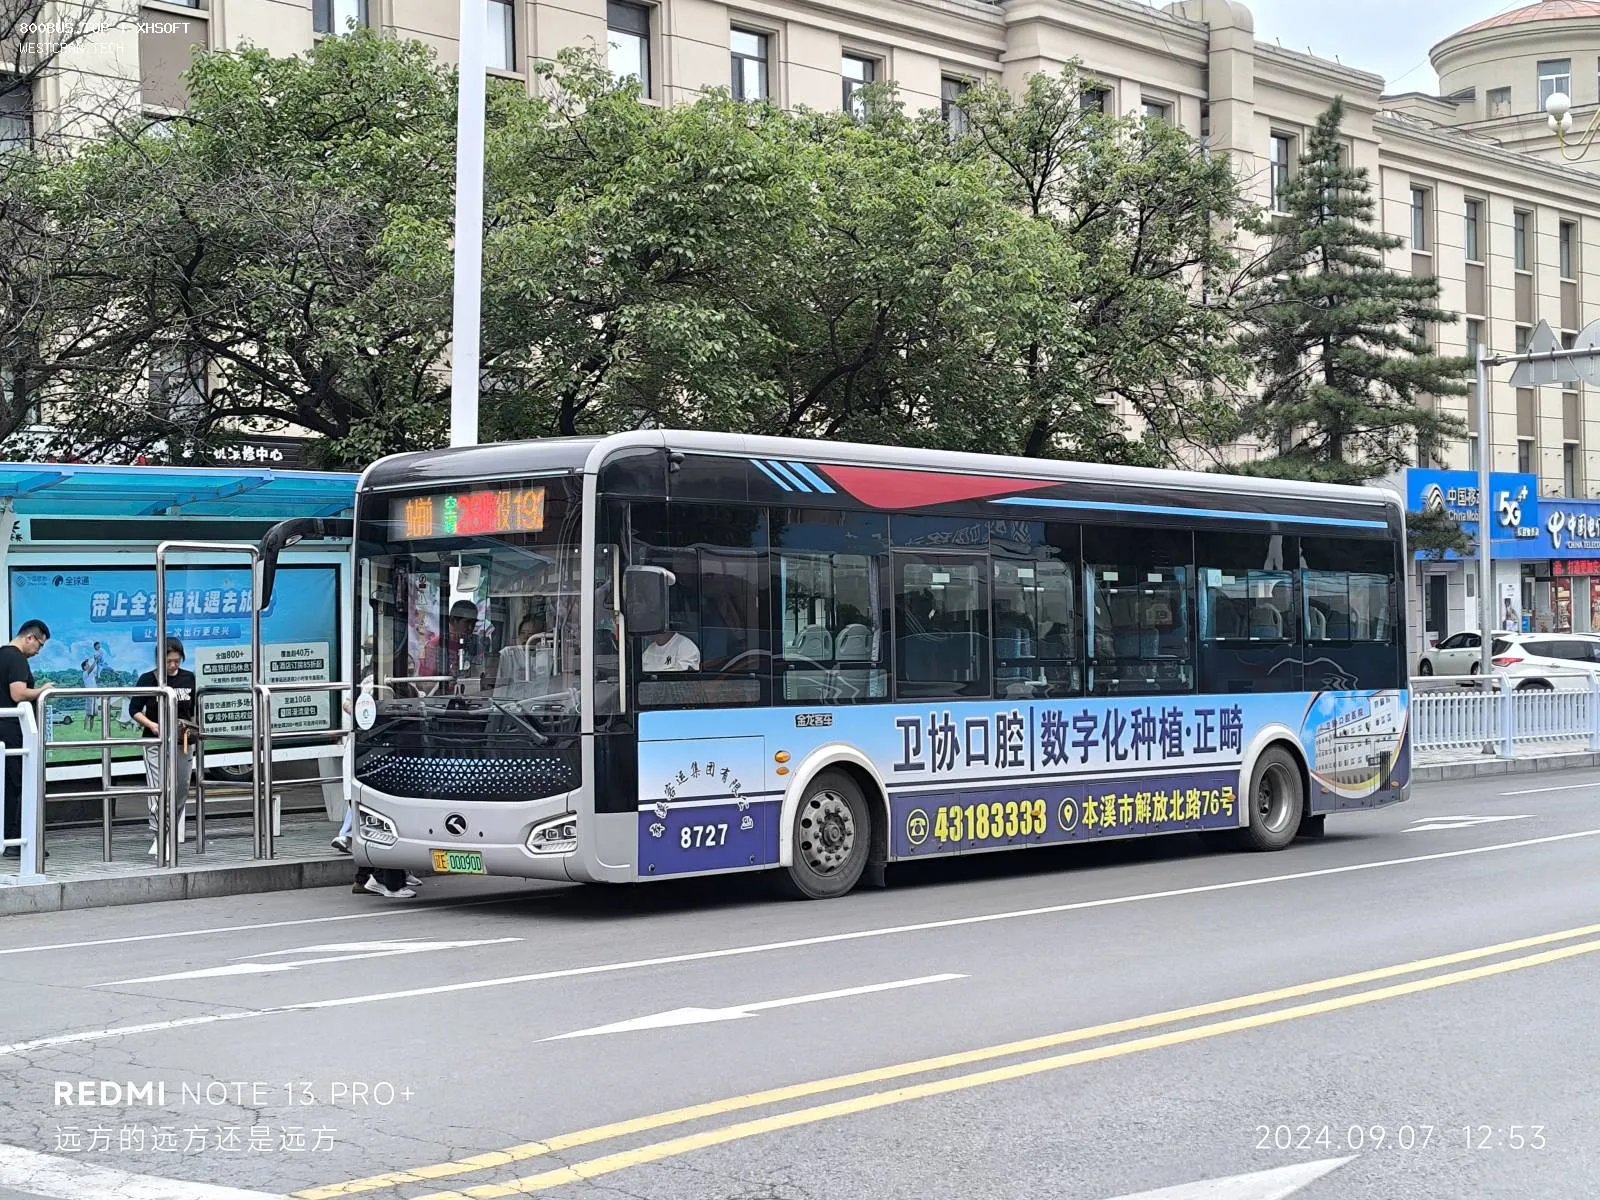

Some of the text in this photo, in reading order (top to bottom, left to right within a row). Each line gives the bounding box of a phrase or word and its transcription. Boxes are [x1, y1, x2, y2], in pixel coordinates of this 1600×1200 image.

[934, 786, 1235, 843] 43183333 本溪市解放北路76号
[680, 823, 728, 849] 8727
